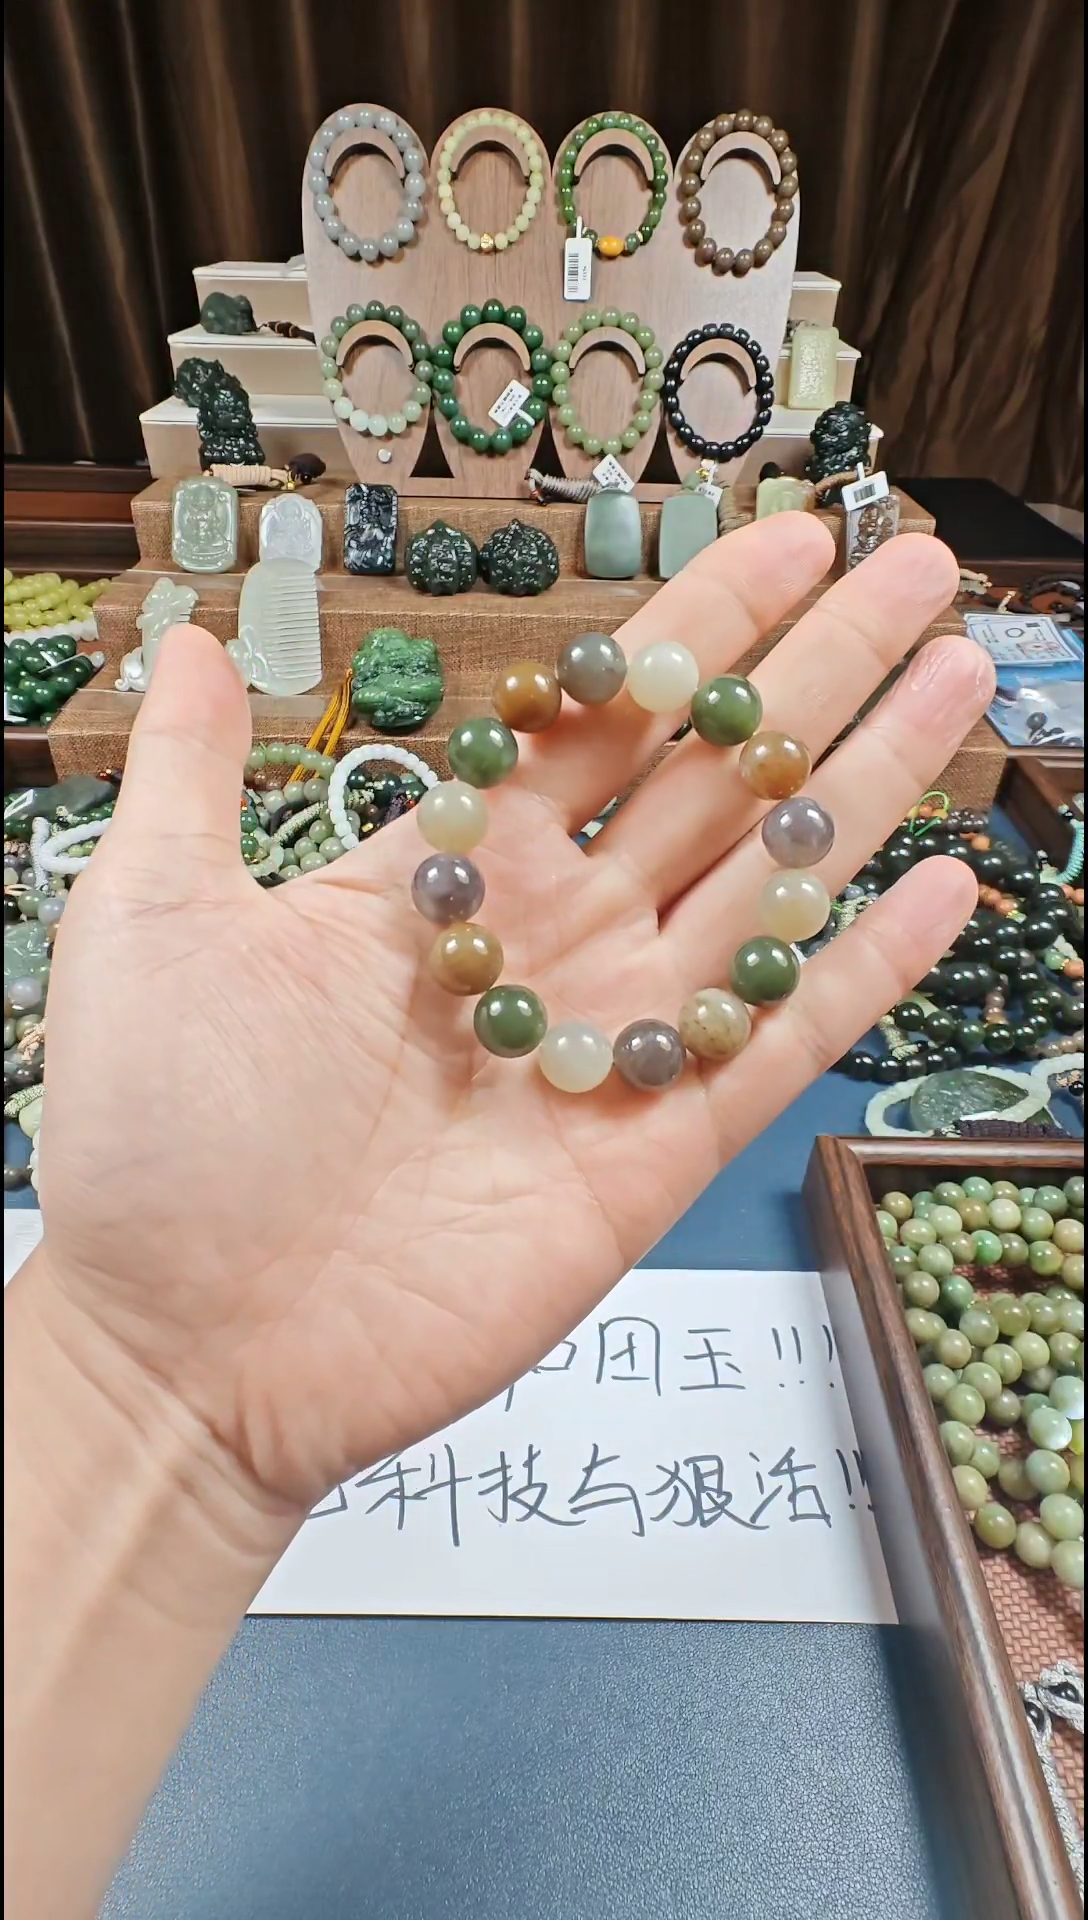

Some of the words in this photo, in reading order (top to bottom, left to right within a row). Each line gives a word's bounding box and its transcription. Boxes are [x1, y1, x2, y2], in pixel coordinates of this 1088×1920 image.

[306, 1443, 873, 1547] 科技与狠活!!
